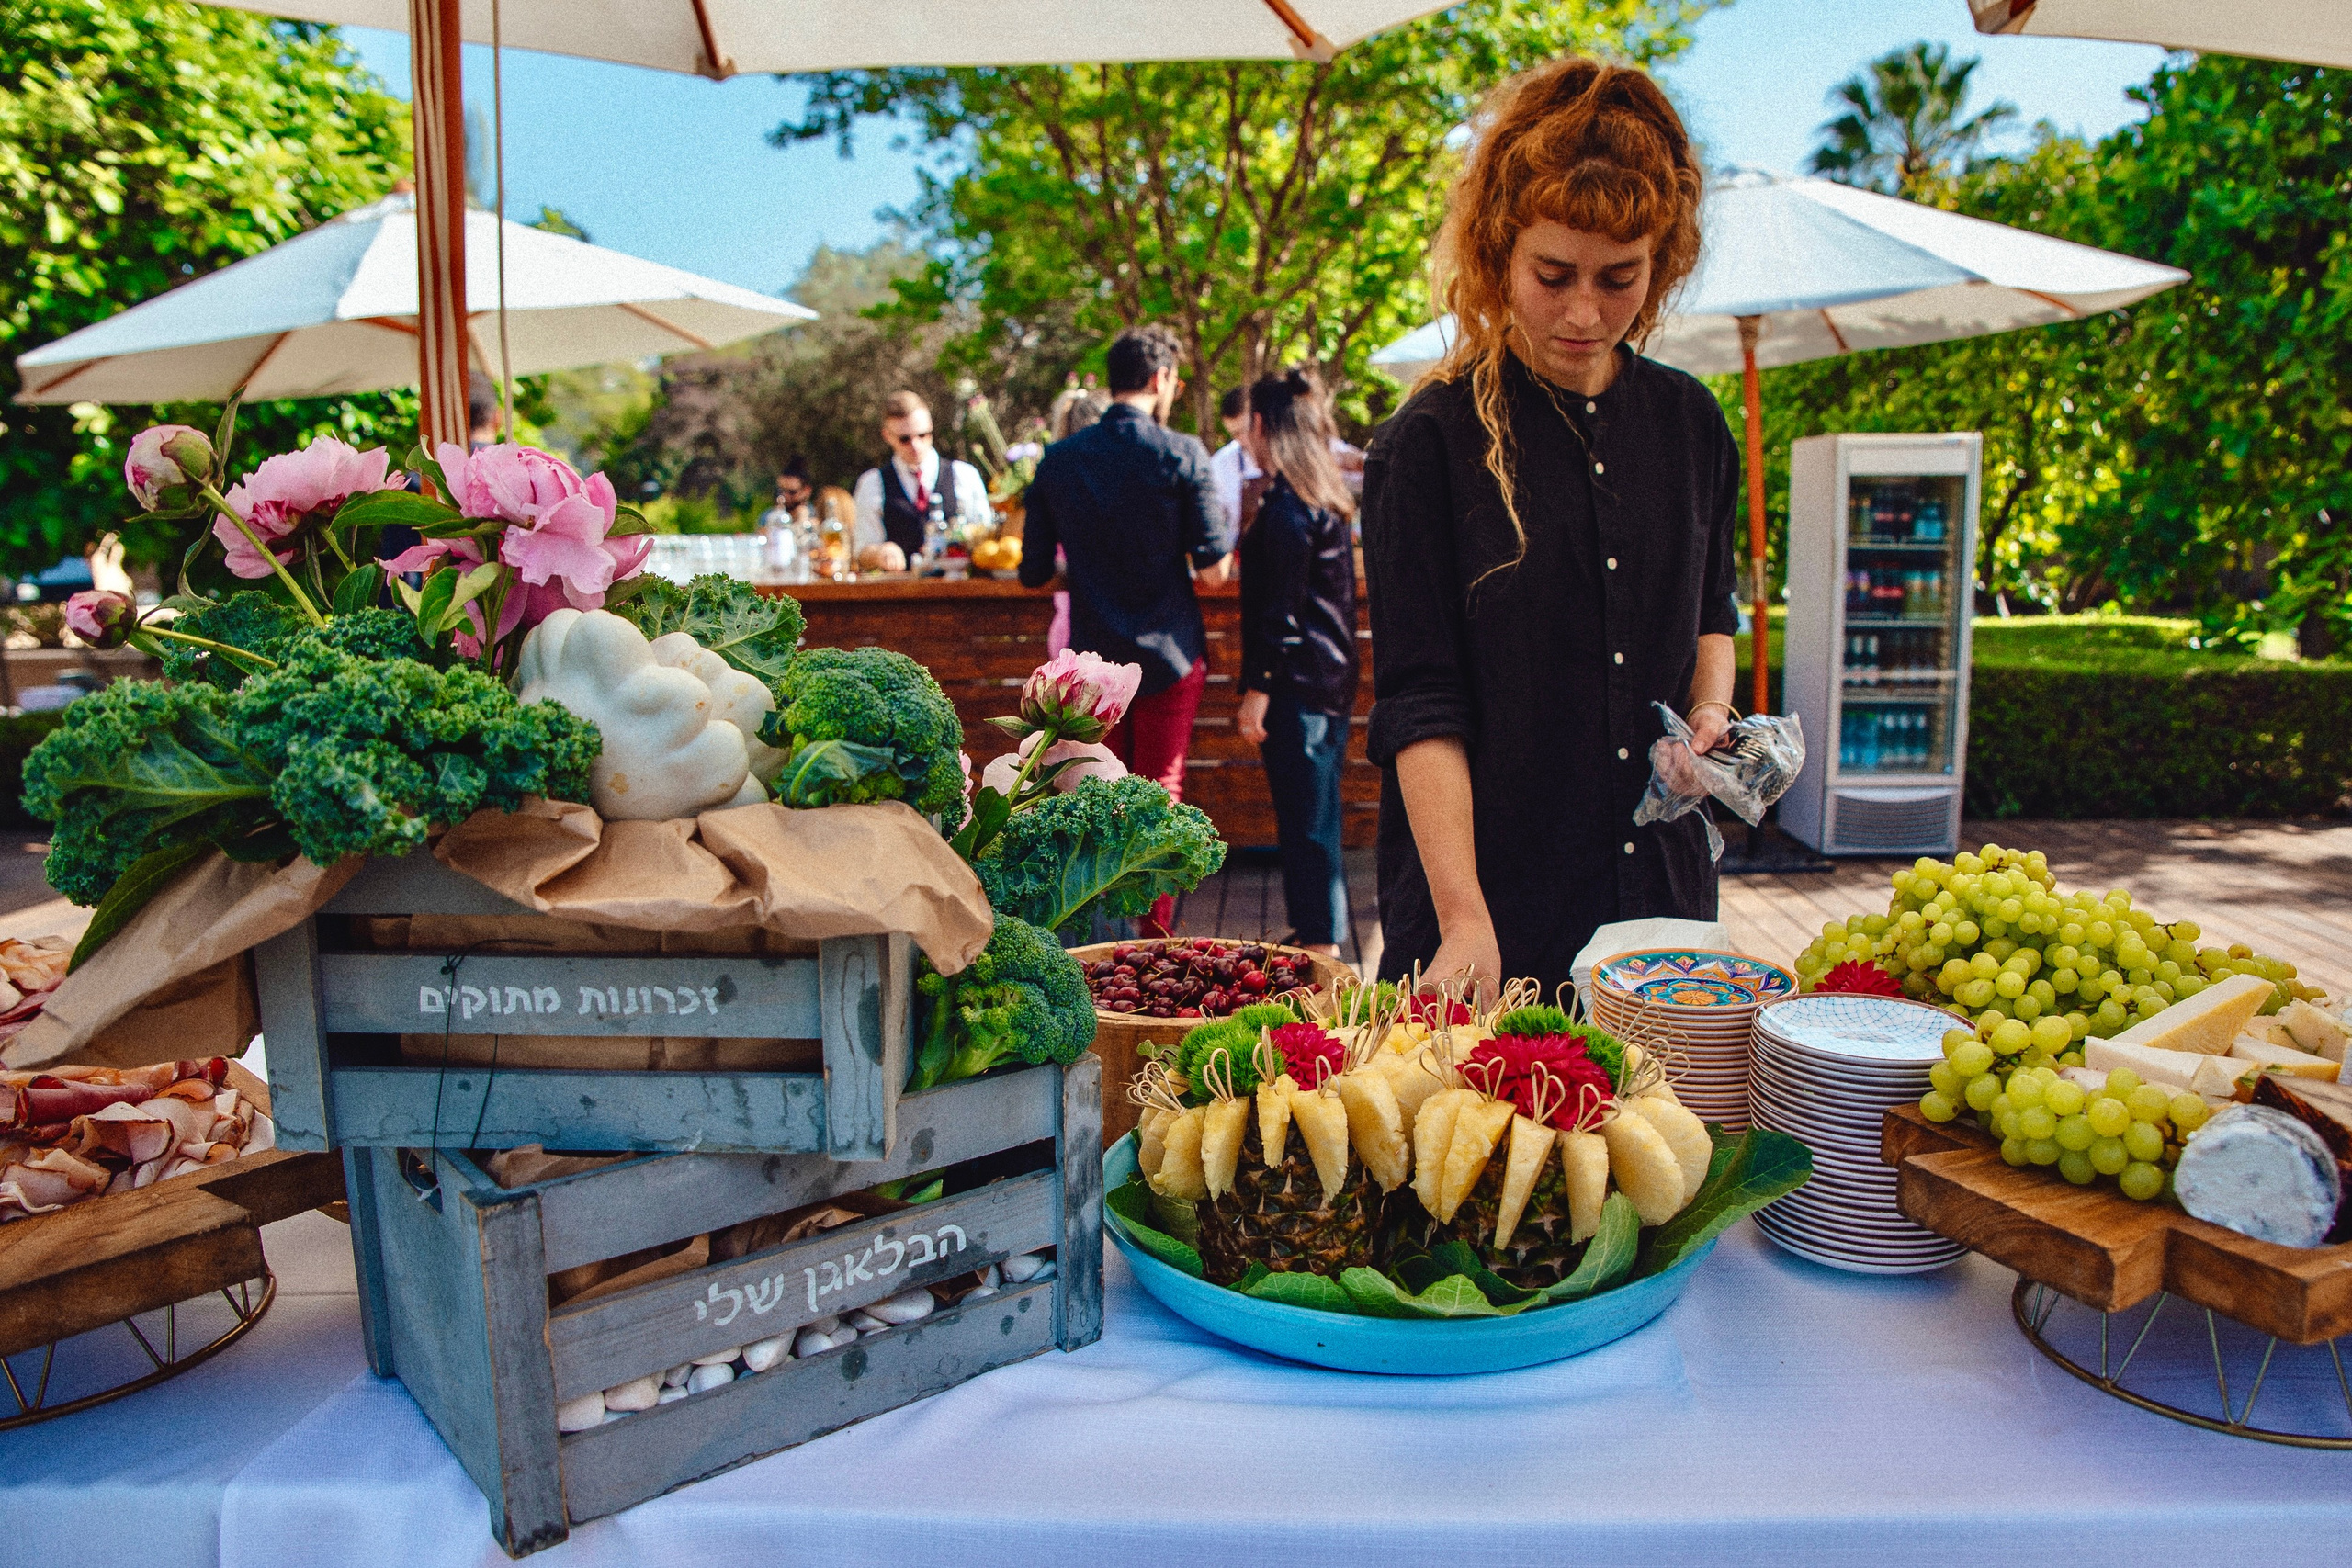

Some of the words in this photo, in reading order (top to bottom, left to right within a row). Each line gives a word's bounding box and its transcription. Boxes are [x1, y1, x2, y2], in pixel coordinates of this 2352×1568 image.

[419, 985, 562, 1021] מתוקים
[577, 985, 719, 1016] זכרונות
[803, 1224, 967, 1313] הבלאגן
[694, 1273, 784, 1326] שלי
